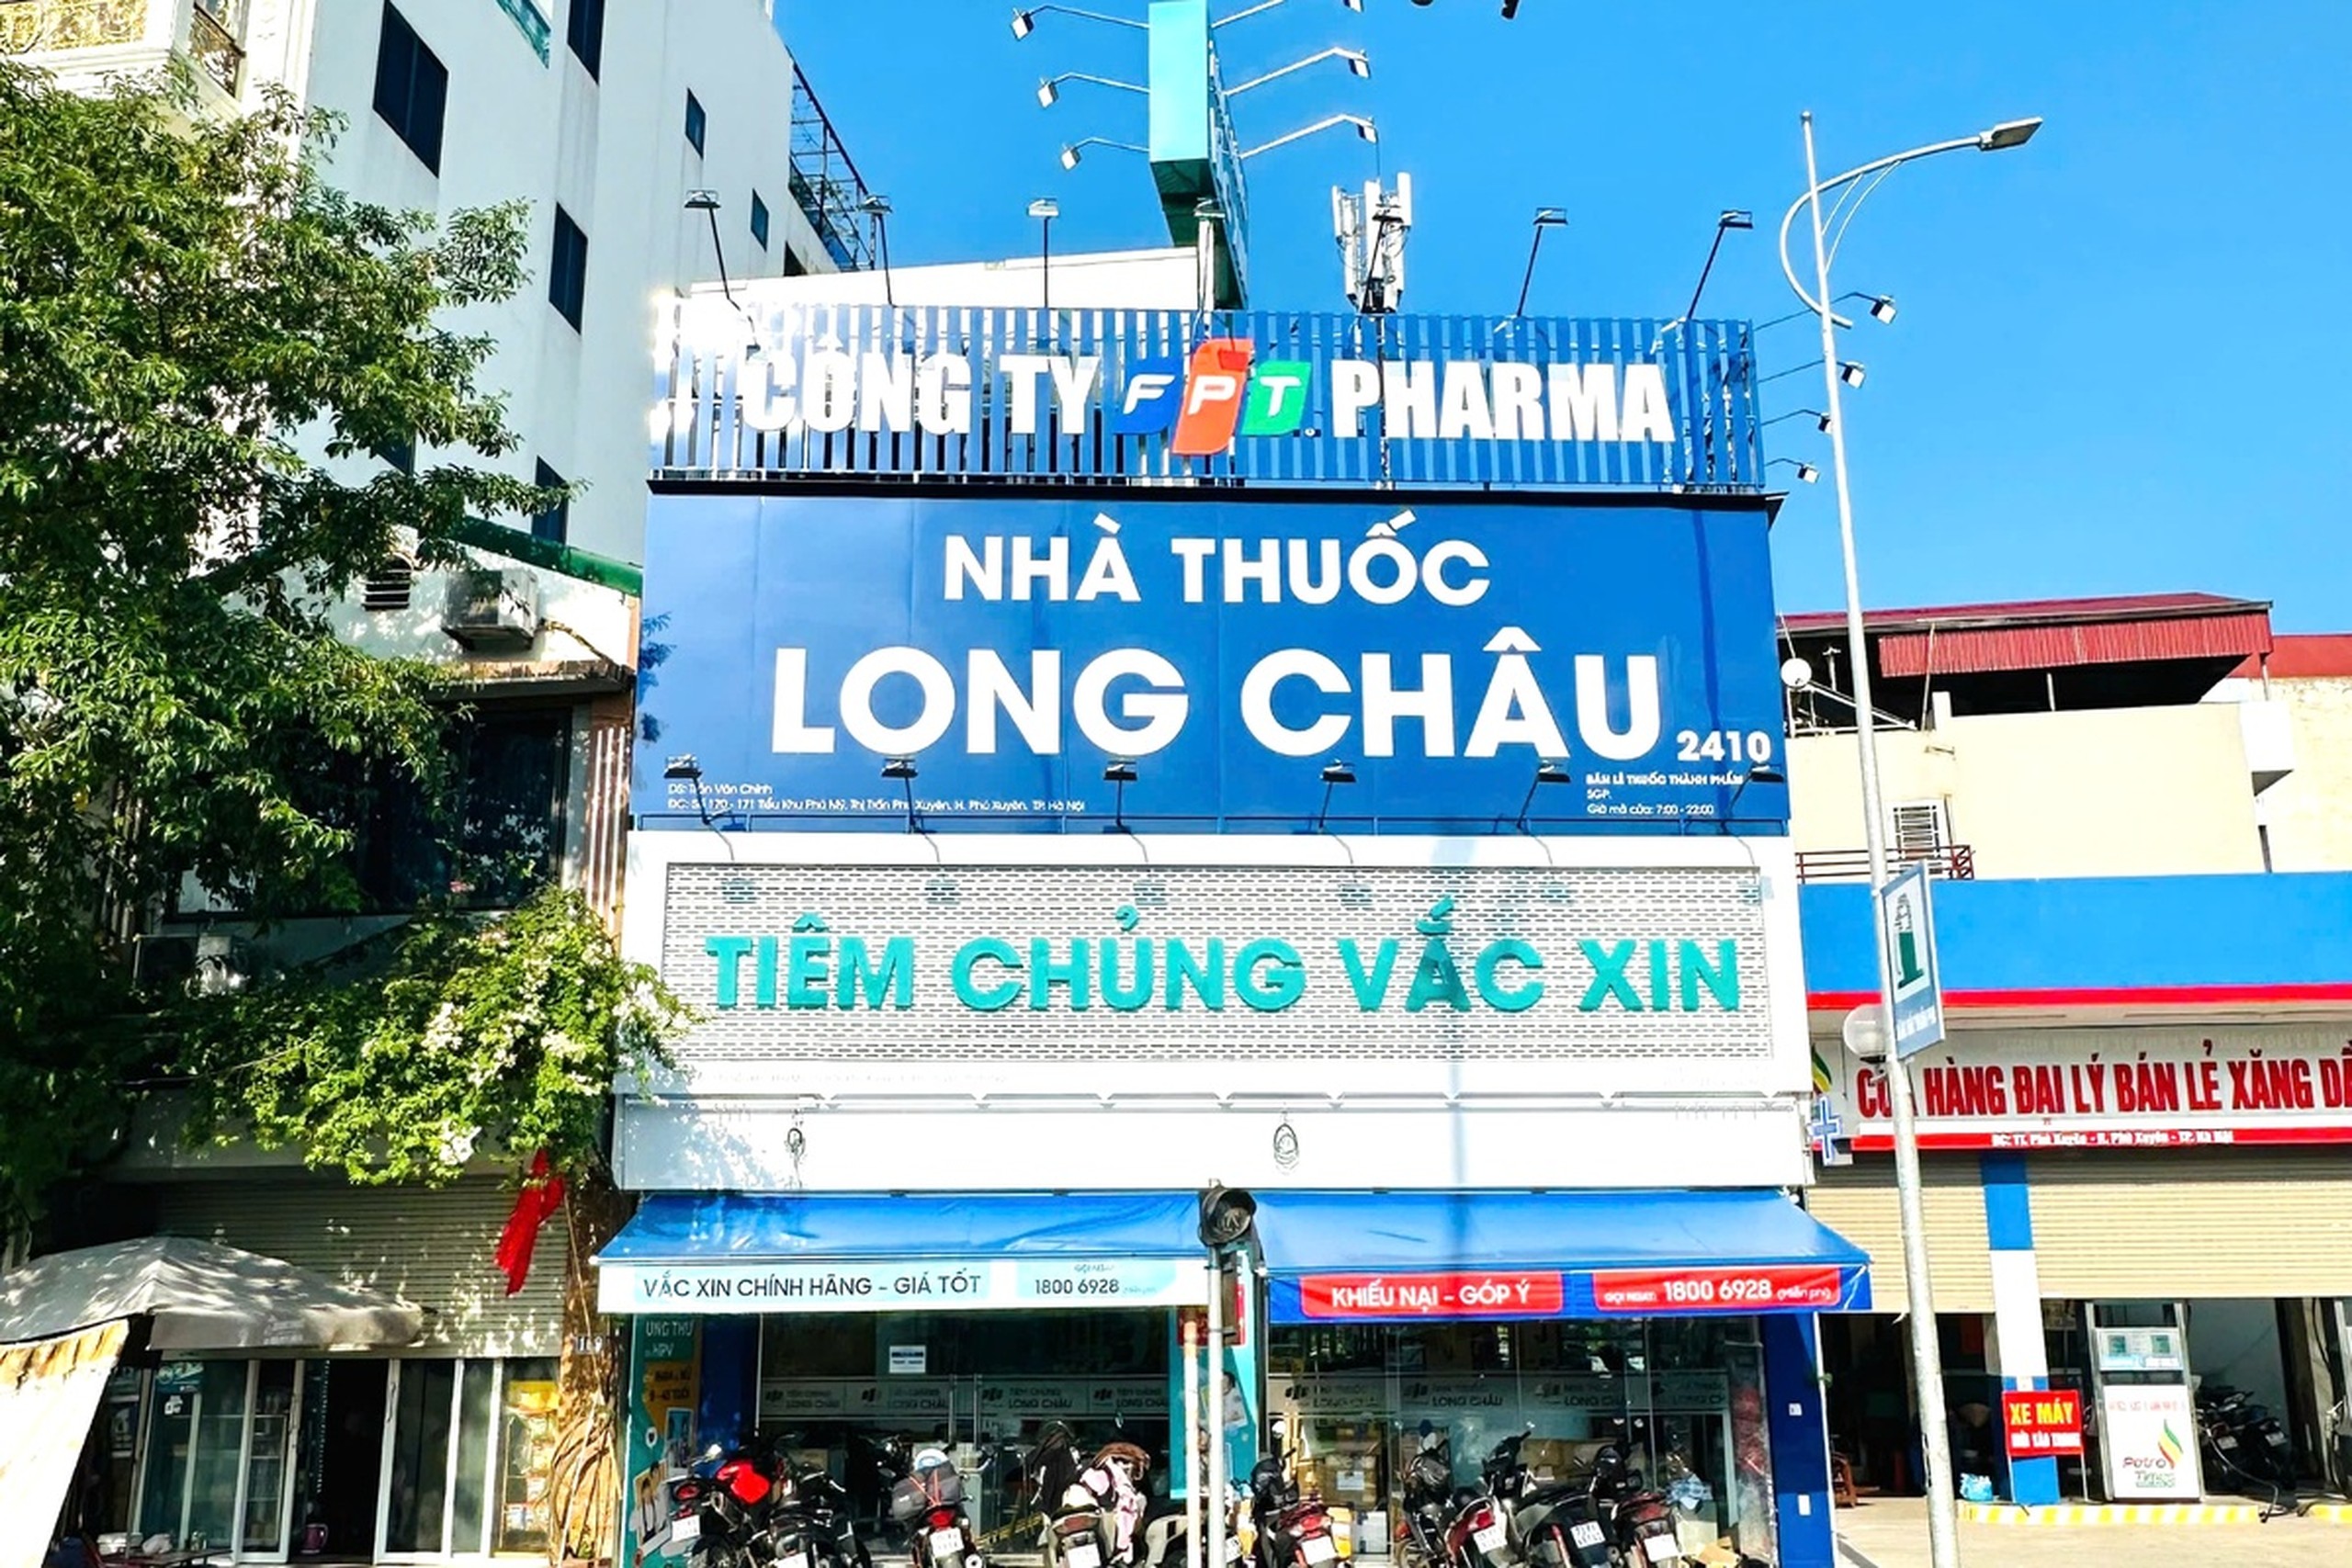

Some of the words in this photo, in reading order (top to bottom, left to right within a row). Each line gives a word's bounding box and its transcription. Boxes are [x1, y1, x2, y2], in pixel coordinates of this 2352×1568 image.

[742, 334, 970, 434] CÔNG
[1000, 355, 1101, 434] TY
[1331, 359, 1677, 442] PHARMA
[944, 512, 1141, 603] NHÀ
[1172, 509, 1491, 607] THUỐC
[772, 646, 1189, 758] LONG
[1240, 626, 1661, 761] CHÂU
[1676, 729, 1771, 763] 2410
[705, 912, 915, 1011] TIÊM
[950, 904, 1306, 1014] CHỦNG
[1336, 895, 1545, 1013] VẮC
[1577, 937, 1740, 1012] XIN
[1923, 1056, 2007, 1116] HÀNG
[2071, 1052, 2105, 1114] LÝ
[2113, 1051, 2179, 1112] BÁN
[2184, 1039, 2222, 1111] LẺ
[2226, 1048, 2314, 1110] XĂNG
[643, 1269, 690, 1298] VẮC
[695, 1278, 731, 1298] XIN
[737, 1273, 804, 1297] CHÍNH
[894, 1271, 932, 1295] GIÁ
[937, 1267, 981, 1294] TỐT
[1035, 1278, 1073, 1295] 1800
[1078, 1278, 1120, 1295] 6928
[1332, 1279, 1395, 1307] KHIẾU
[1400, 1285, 1438, 1314] NẠI
[1459, 1279, 1510, 1304] GÓP
[1516, 1278, 1530, 1303] Ý
[1664, 1280, 1714, 1302] 1800
[1719, 1279, 1773, 1301] 6928
[2008, 1402, 2032, 1427] XE
[2035, 1396, 2074, 1425] MÁY
